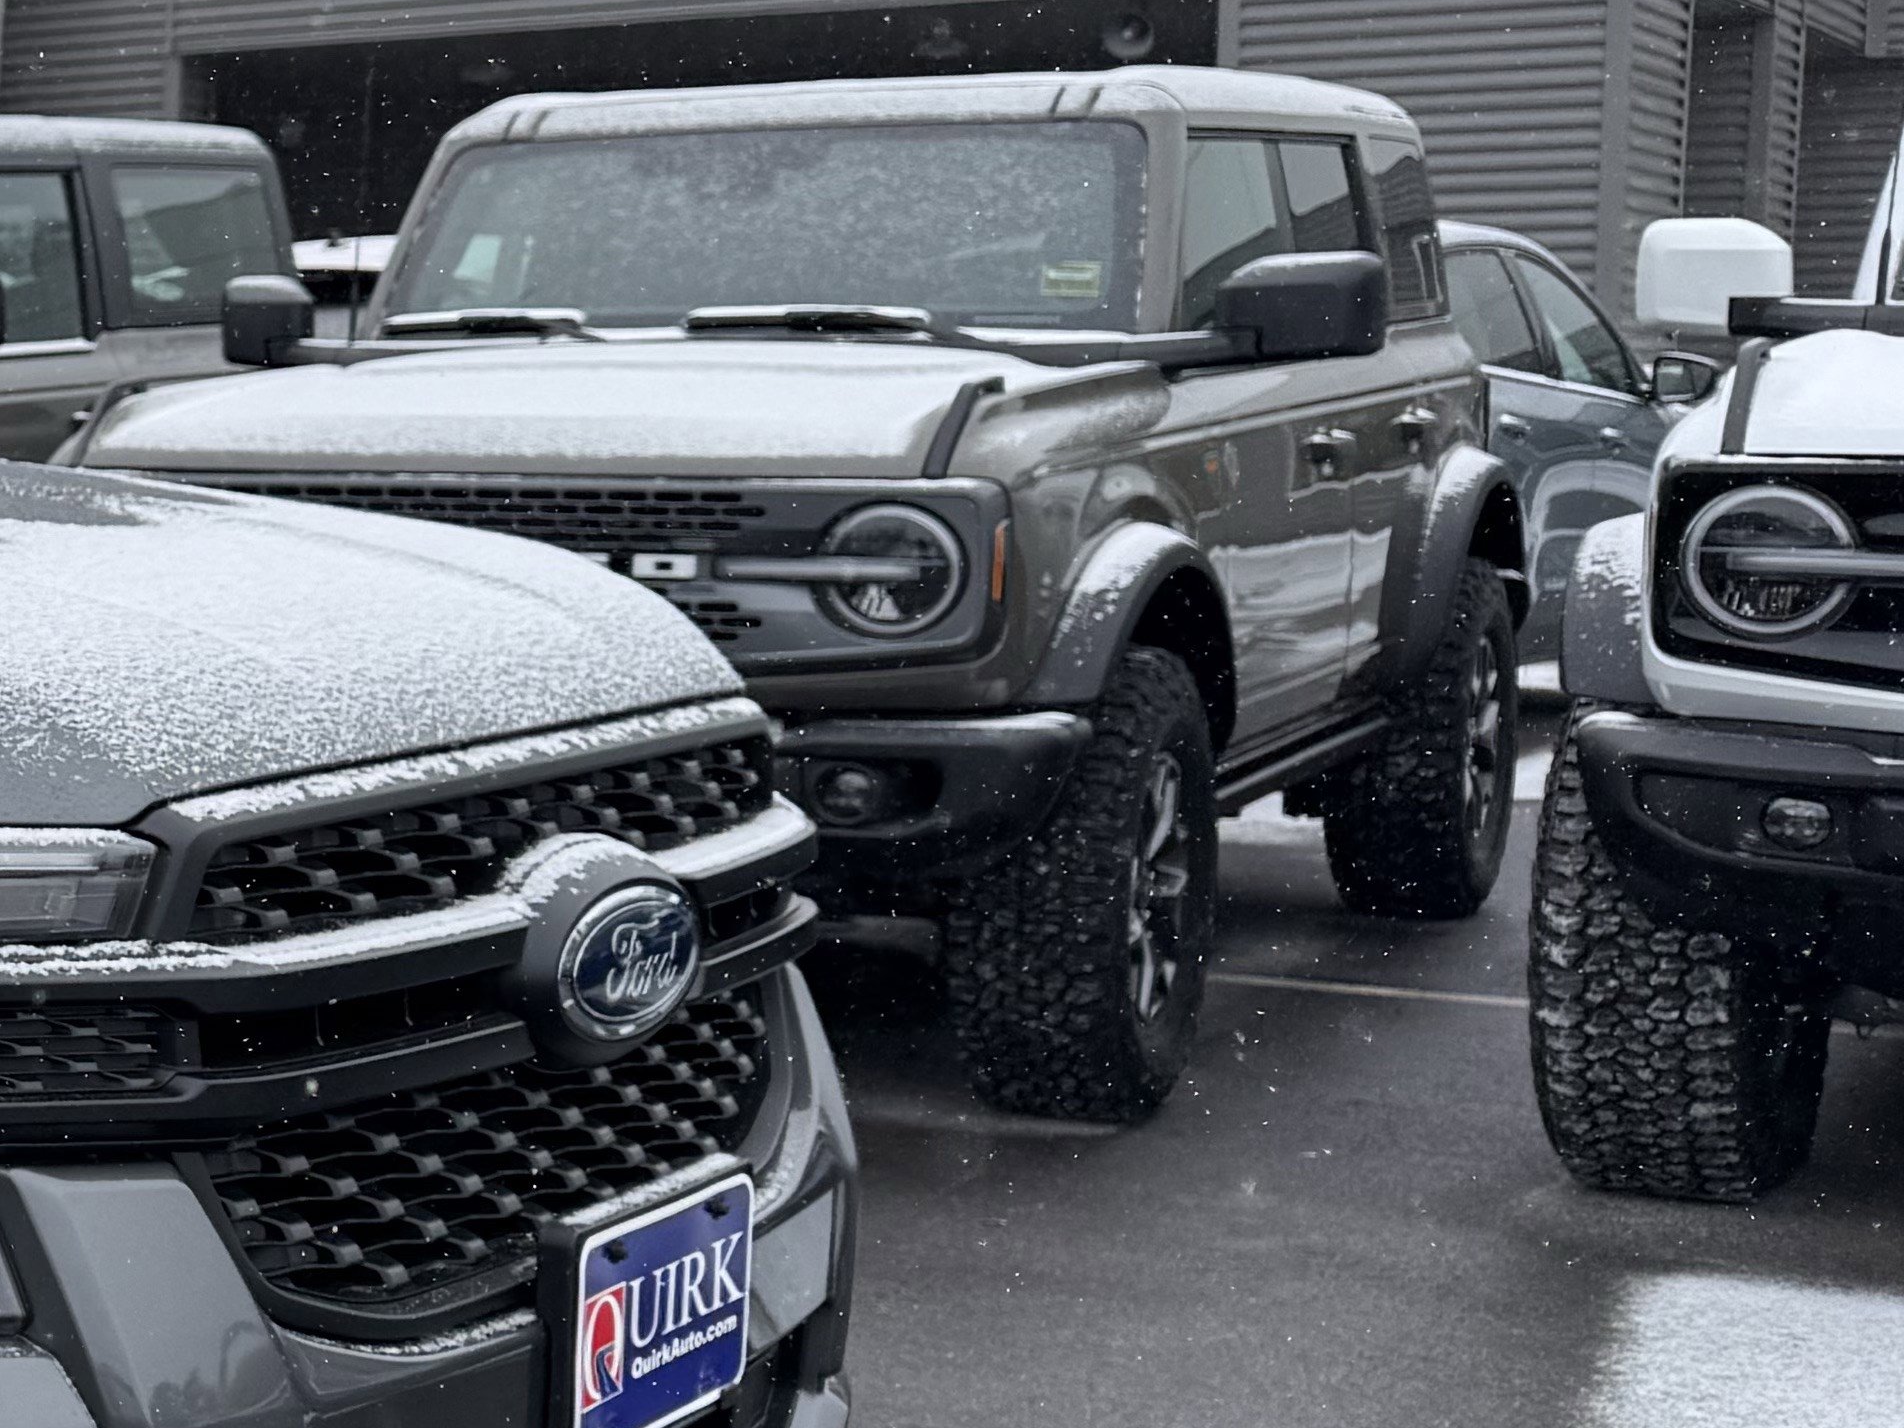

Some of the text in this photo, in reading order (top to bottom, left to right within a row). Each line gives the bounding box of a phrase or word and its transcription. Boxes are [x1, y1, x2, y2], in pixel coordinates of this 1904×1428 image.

[605, 917, 679, 1004] Ford
[584, 1231, 746, 1402] QUIRK
[630, 1313, 738, 1380] QuirkAuto.com
